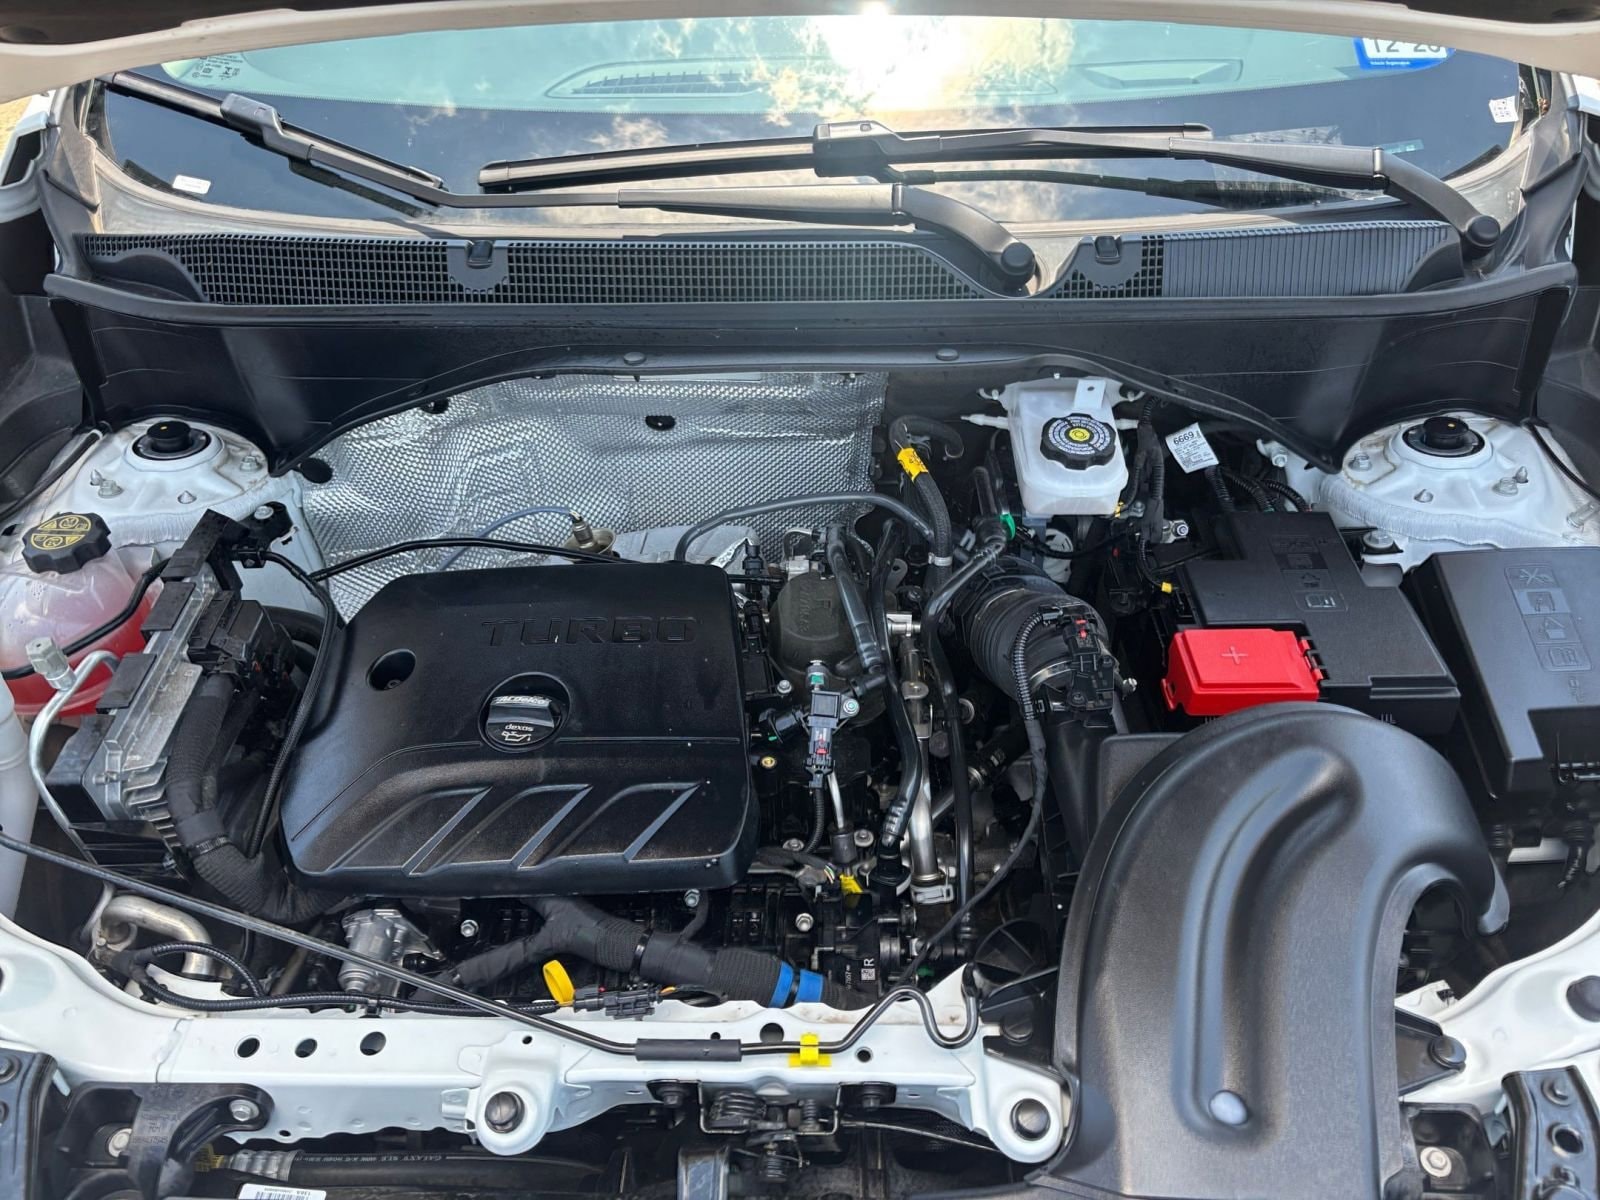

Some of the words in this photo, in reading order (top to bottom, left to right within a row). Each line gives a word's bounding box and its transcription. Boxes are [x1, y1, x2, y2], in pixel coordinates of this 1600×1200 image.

[1173, 431, 1195, 445] 6669
[481, 616, 697, 646] TURBO
[505, 724, 535, 732] dexos
